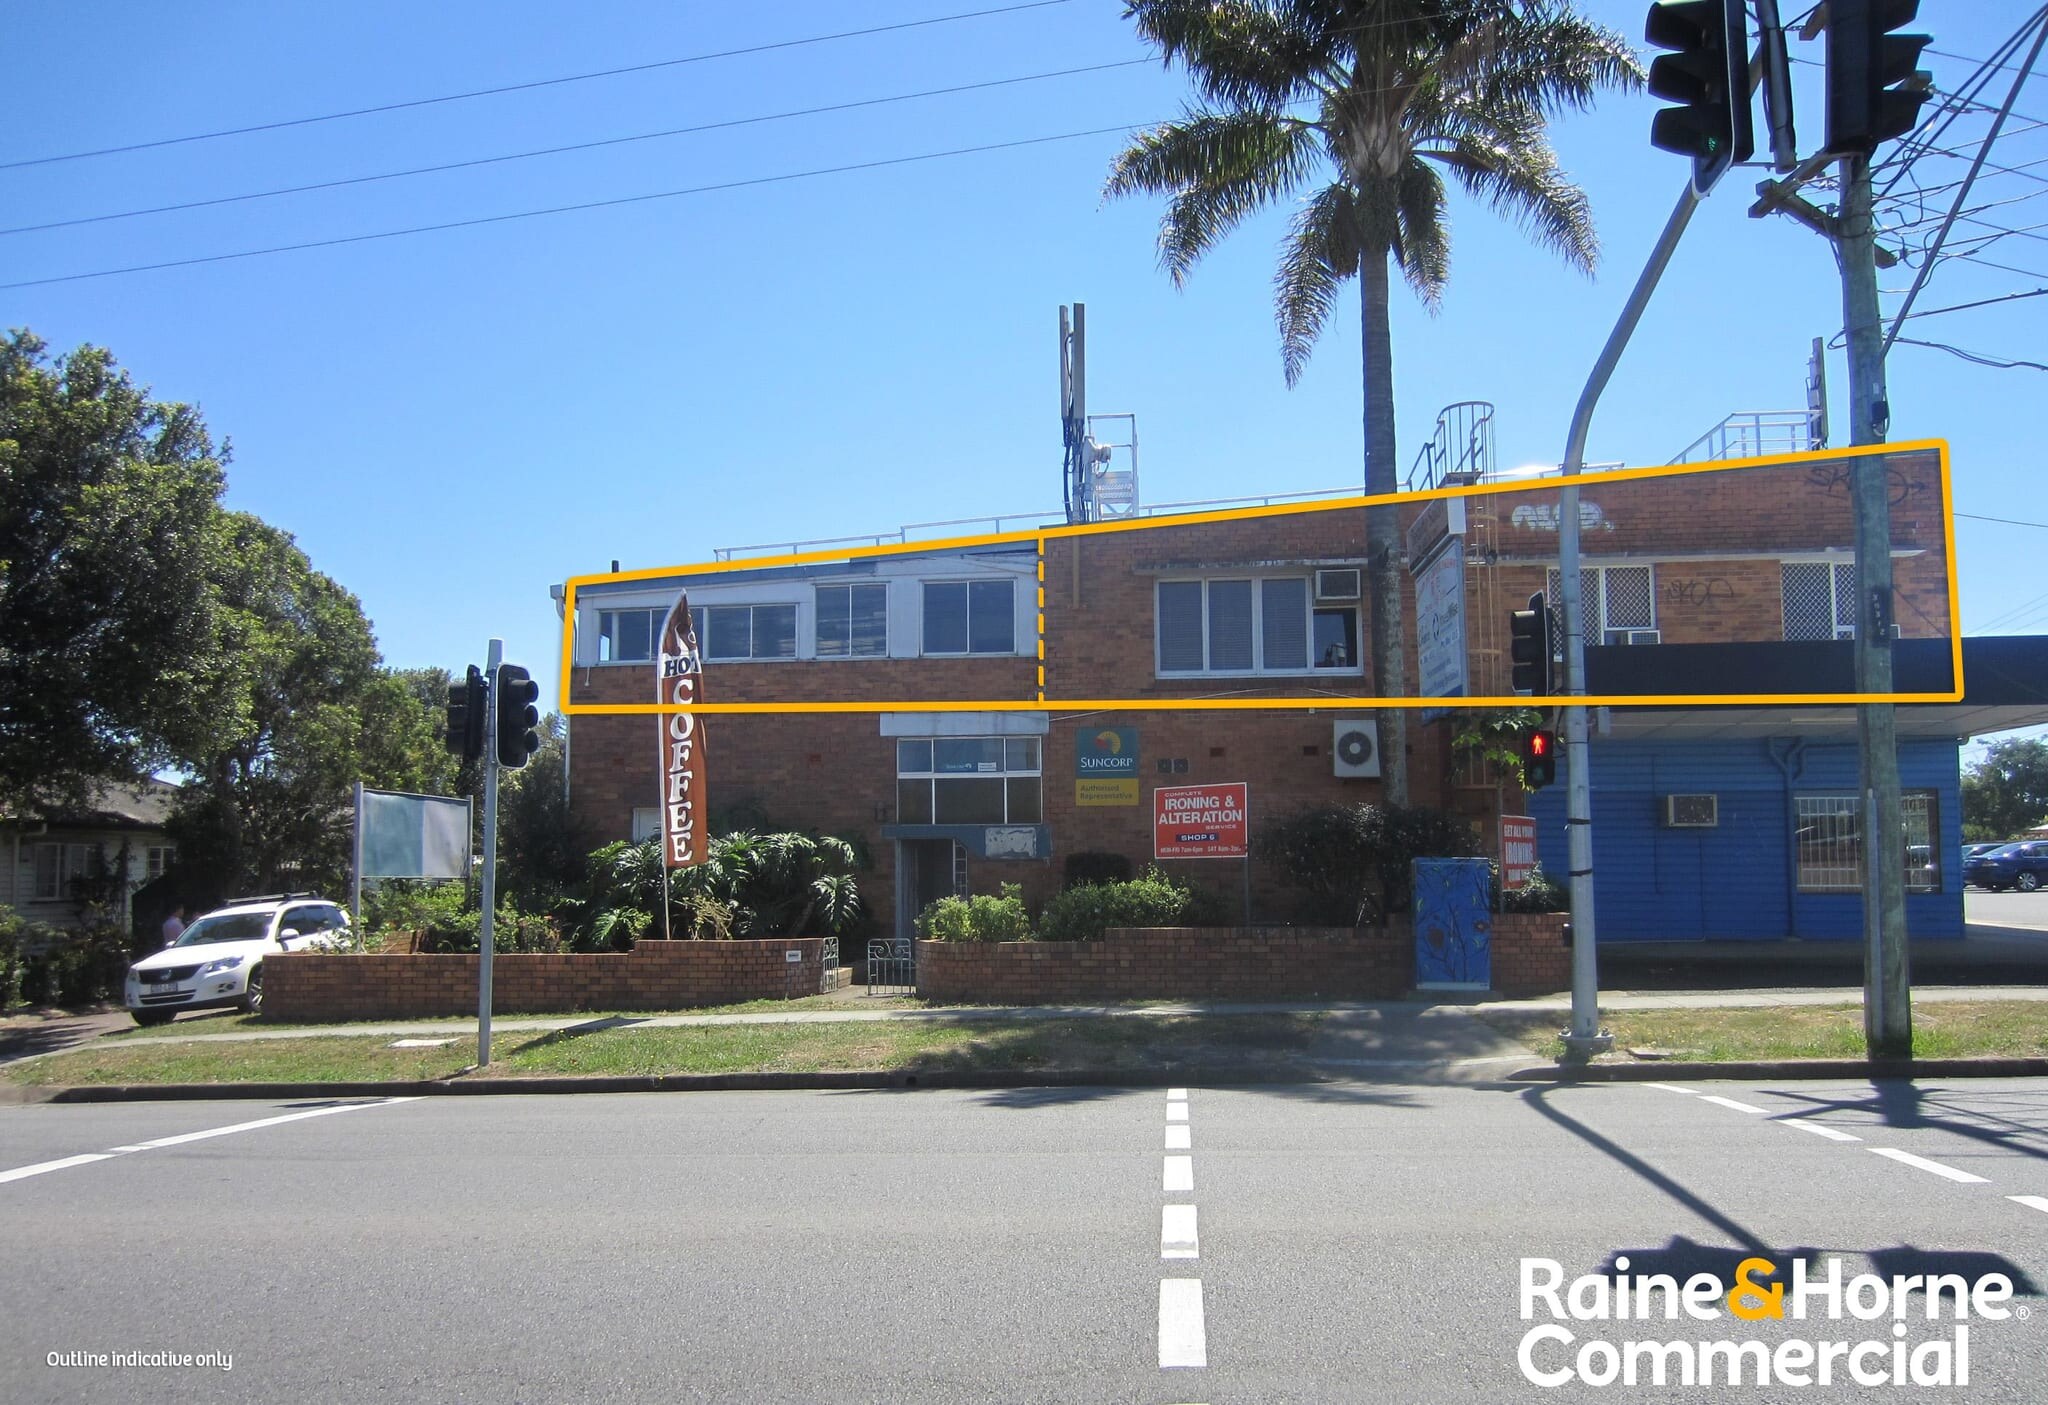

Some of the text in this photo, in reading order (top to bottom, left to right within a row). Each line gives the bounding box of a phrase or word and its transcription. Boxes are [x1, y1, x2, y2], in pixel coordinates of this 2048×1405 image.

[668, 679, 694, 861] COFFEE
[1080, 757, 1133, 768] SUNCORP
[1165, 795, 1235, 810] IRONING &
[1159, 809, 1242, 824] ALTERATION
